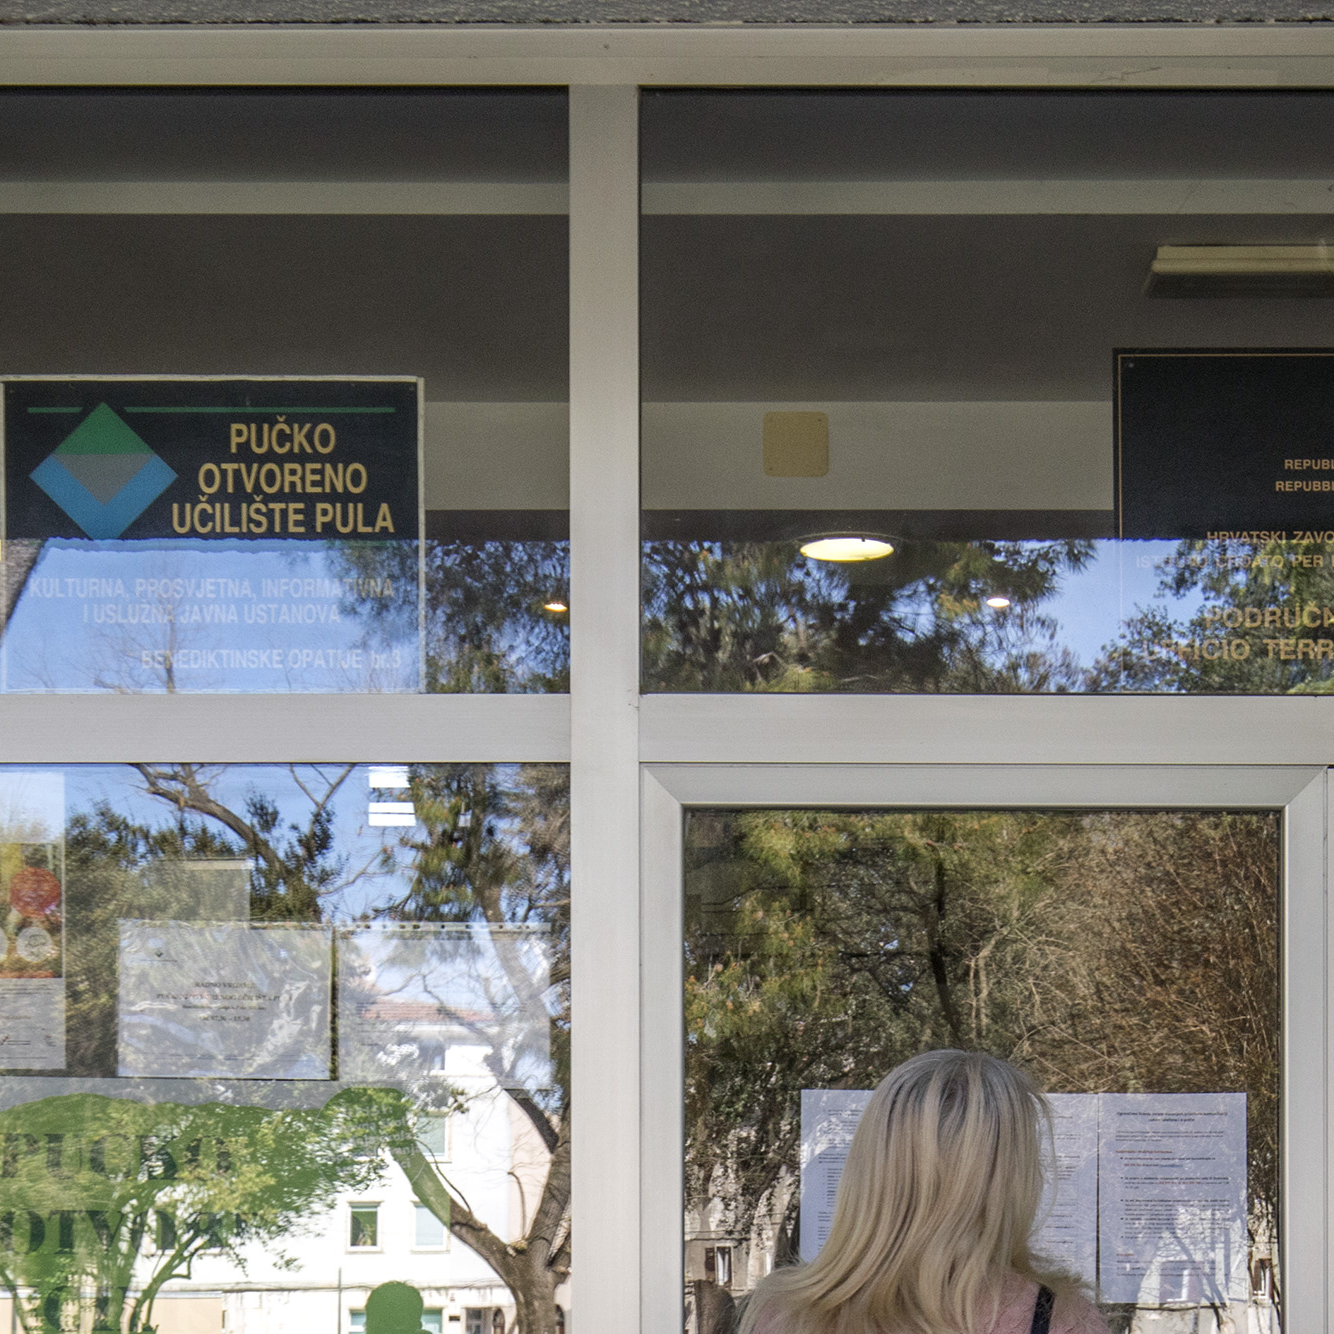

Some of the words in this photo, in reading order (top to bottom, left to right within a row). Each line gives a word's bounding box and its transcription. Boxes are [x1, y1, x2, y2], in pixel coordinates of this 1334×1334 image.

[230, 415, 336, 454] PUČKO
[198, 462, 367, 494] OTVORENO
[172, 495, 306, 534] UČILIŠTE
[315, 502, 395, 533] PULA
[1207, 531, 1286, 544] HRVATSKI
[1292, 555, 1323, 567] PER
[29, 578, 129, 601] KULTURNA,
[136, 578, 256, 601] PROSVJETNA,
[262, 578, 394, 599] INFORMATIVNA
[179, 604, 238, 624] JAVNA
[244, 604, 340, 624] USTANOVA
[142, 650, 283, 669] BENEDIKTINSKE
[288, 650, 362, 669] OPATIJE
